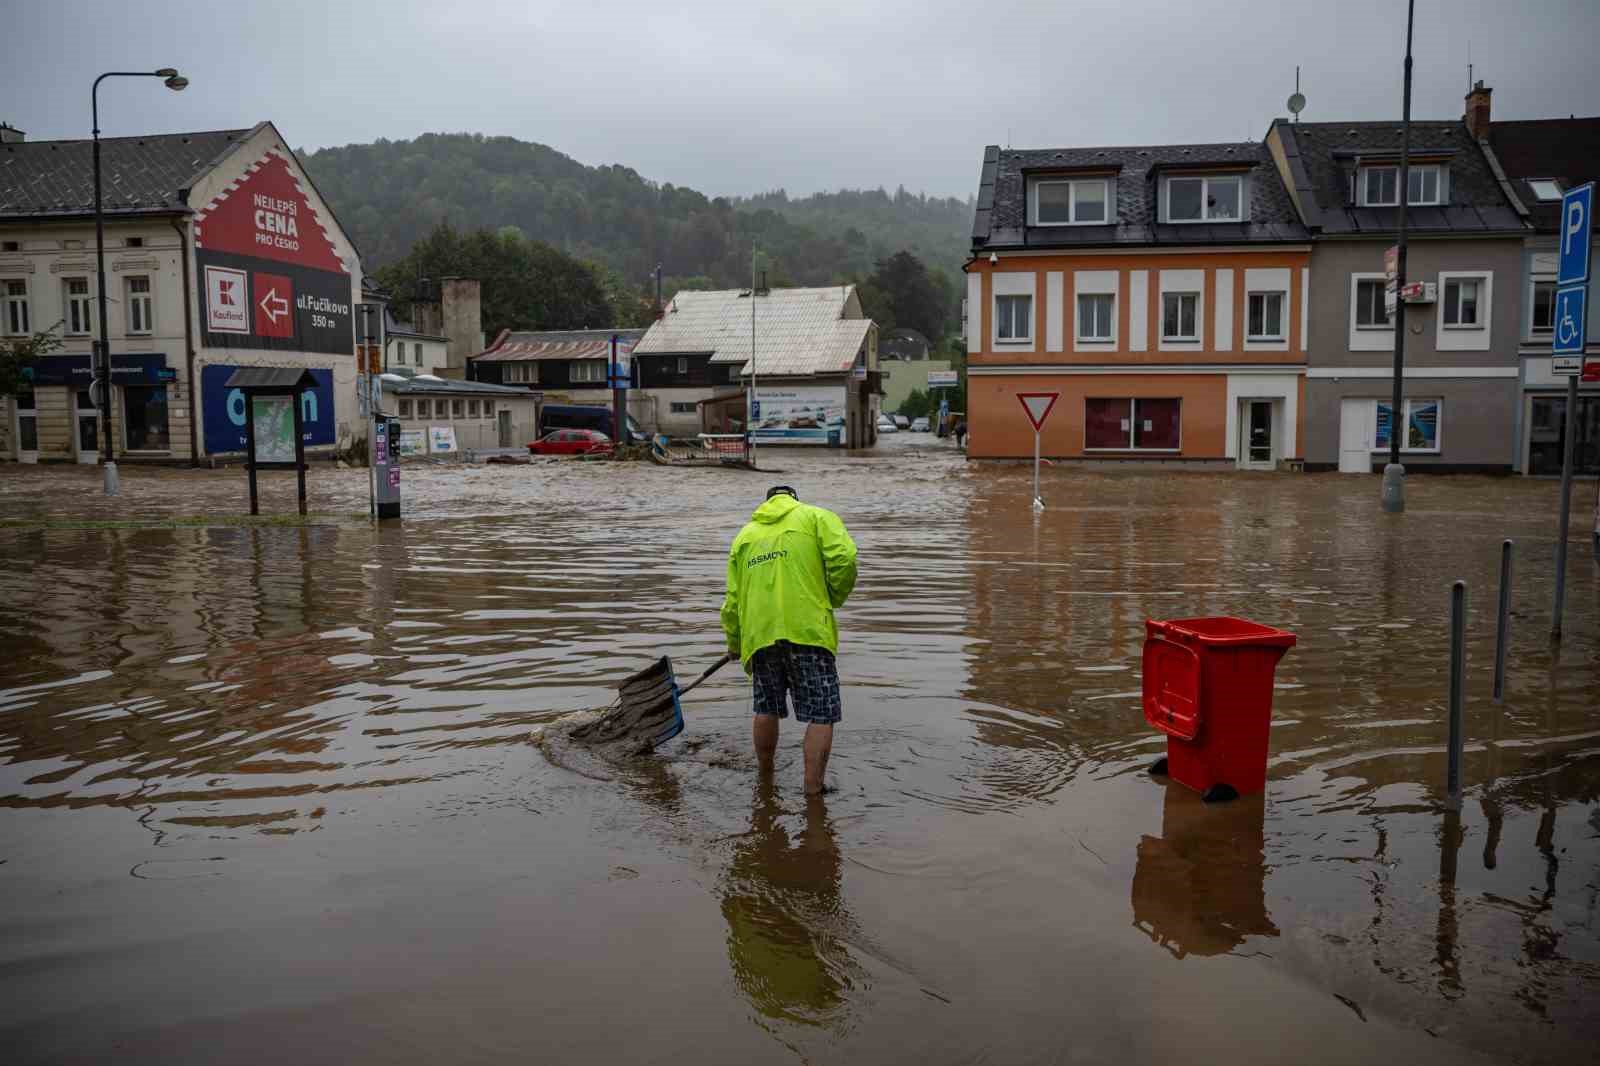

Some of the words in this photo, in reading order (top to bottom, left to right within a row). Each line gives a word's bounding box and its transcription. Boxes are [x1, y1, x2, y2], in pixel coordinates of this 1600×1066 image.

[254, 192, 297, 217] NEJLEPŠÍ
[255, 209, 298, 238] CENA
[1565, 200, 1584, 255] P
[255, 232, 273, 246] PRO
[274, 234, 300, 251] ČESKO
[311, 314, 327, 328] 350
[328, 319, 336, 329] m
